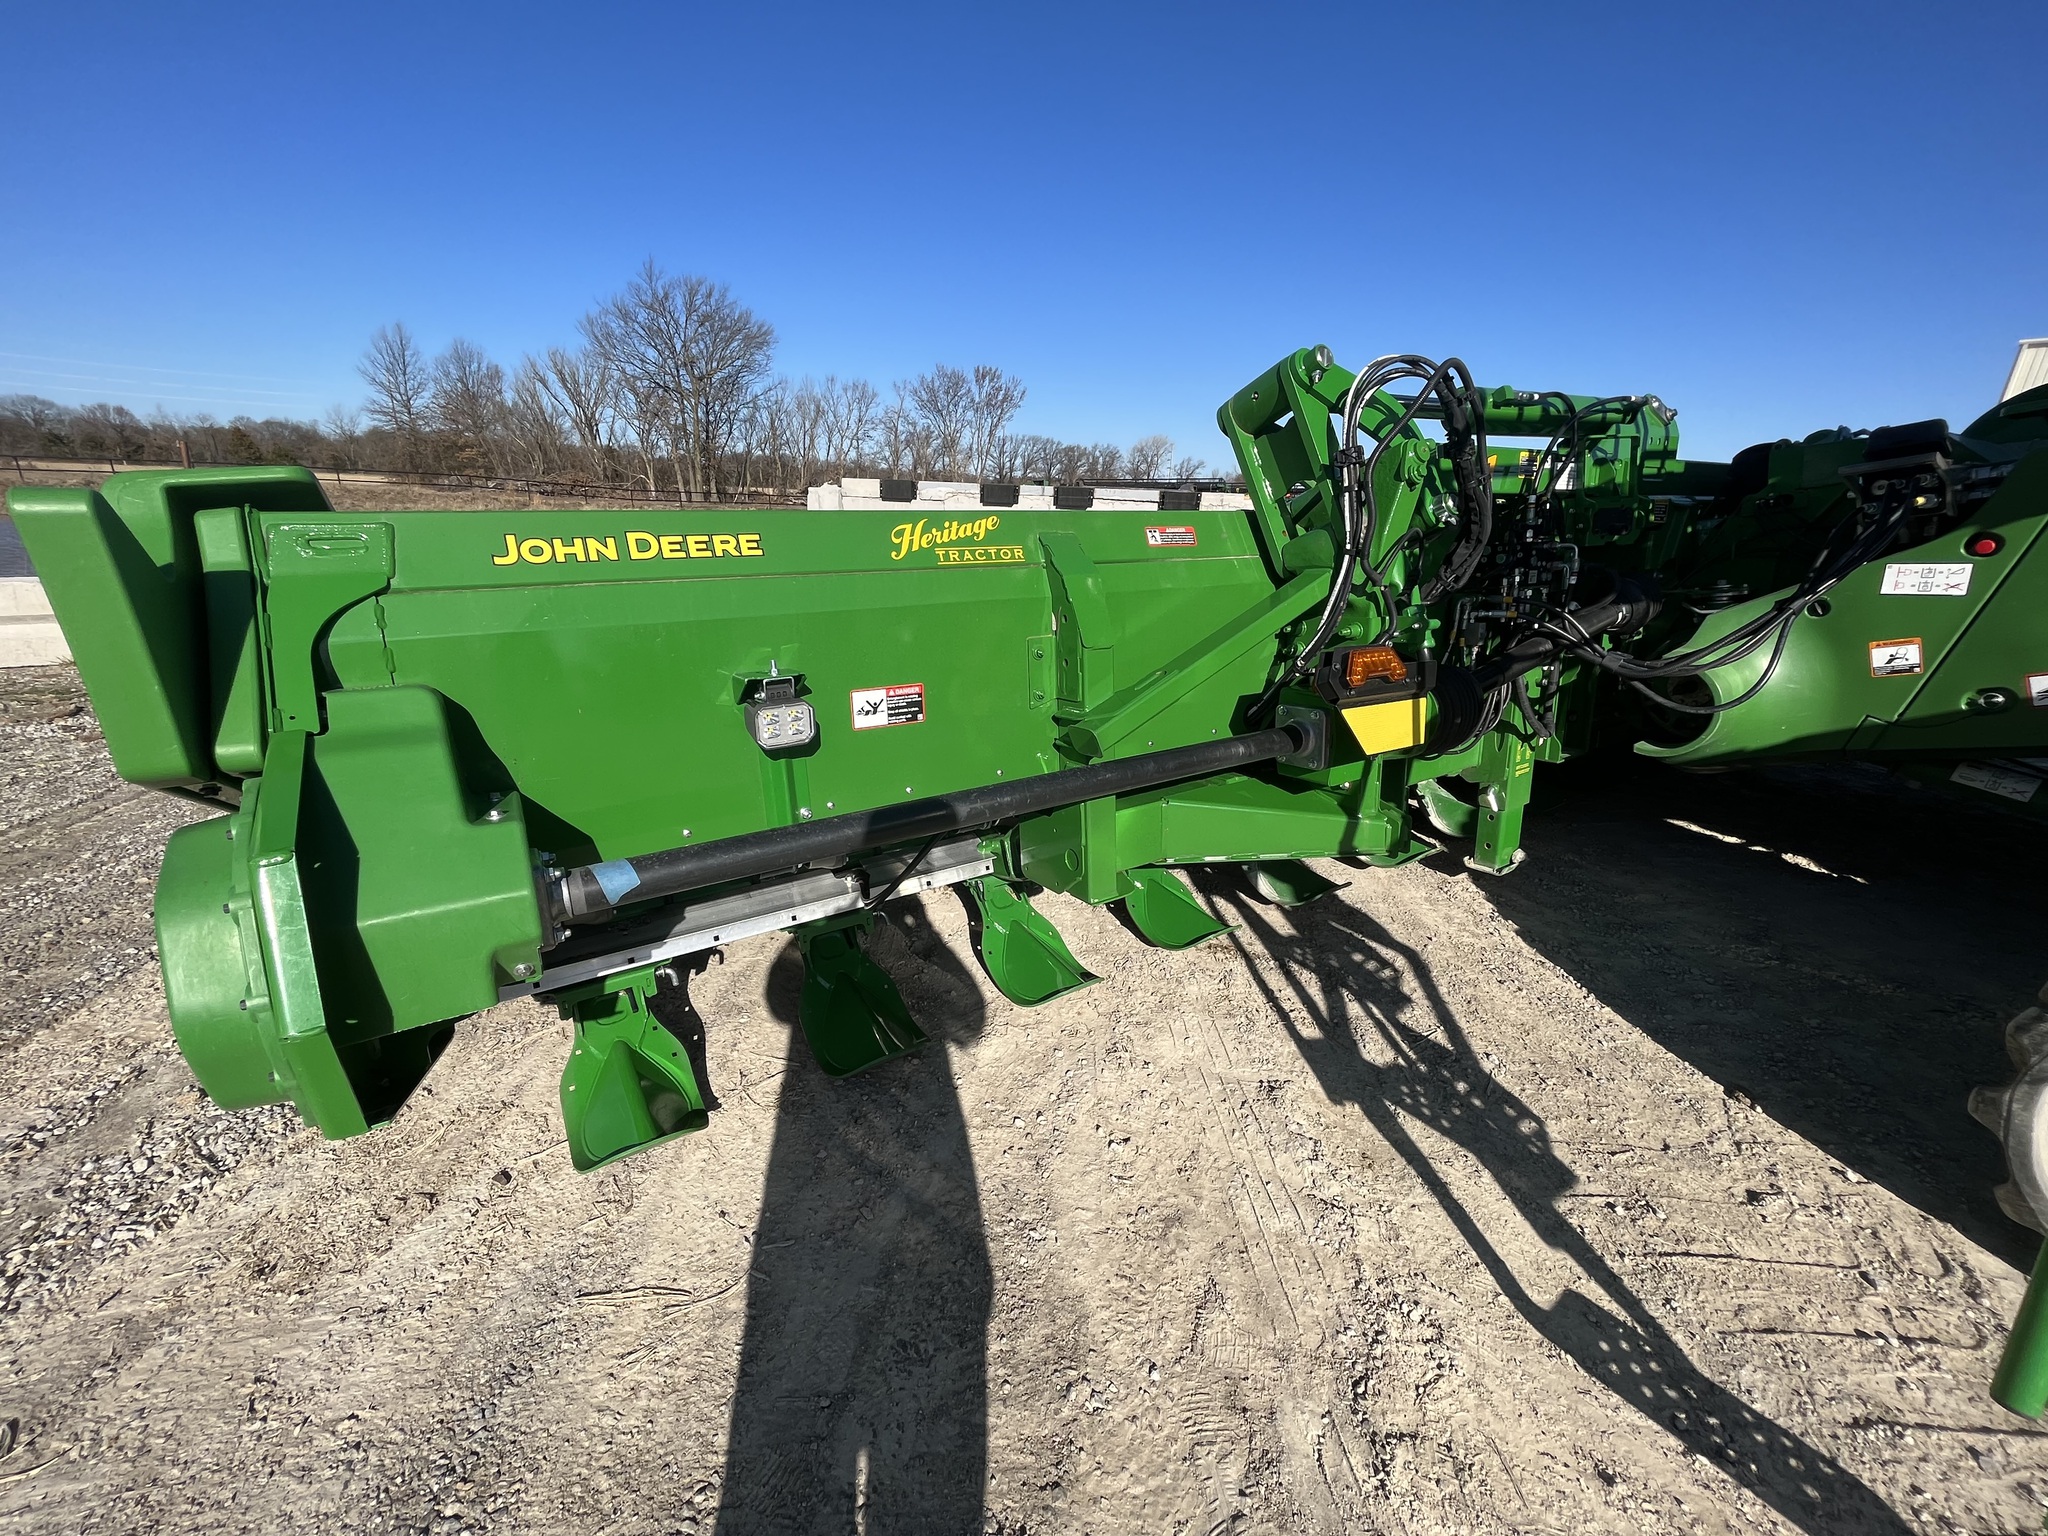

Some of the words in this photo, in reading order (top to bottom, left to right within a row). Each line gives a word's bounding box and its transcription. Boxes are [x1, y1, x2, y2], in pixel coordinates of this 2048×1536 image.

[491, 533, 620, 566] JOHN
[624, 530, 765, 561] DEERE
[890, 515, 1000, 560] Heritage
[935, 548, 1025, 562] TRACTOR
[895, 686, 919, 694] DANGER
